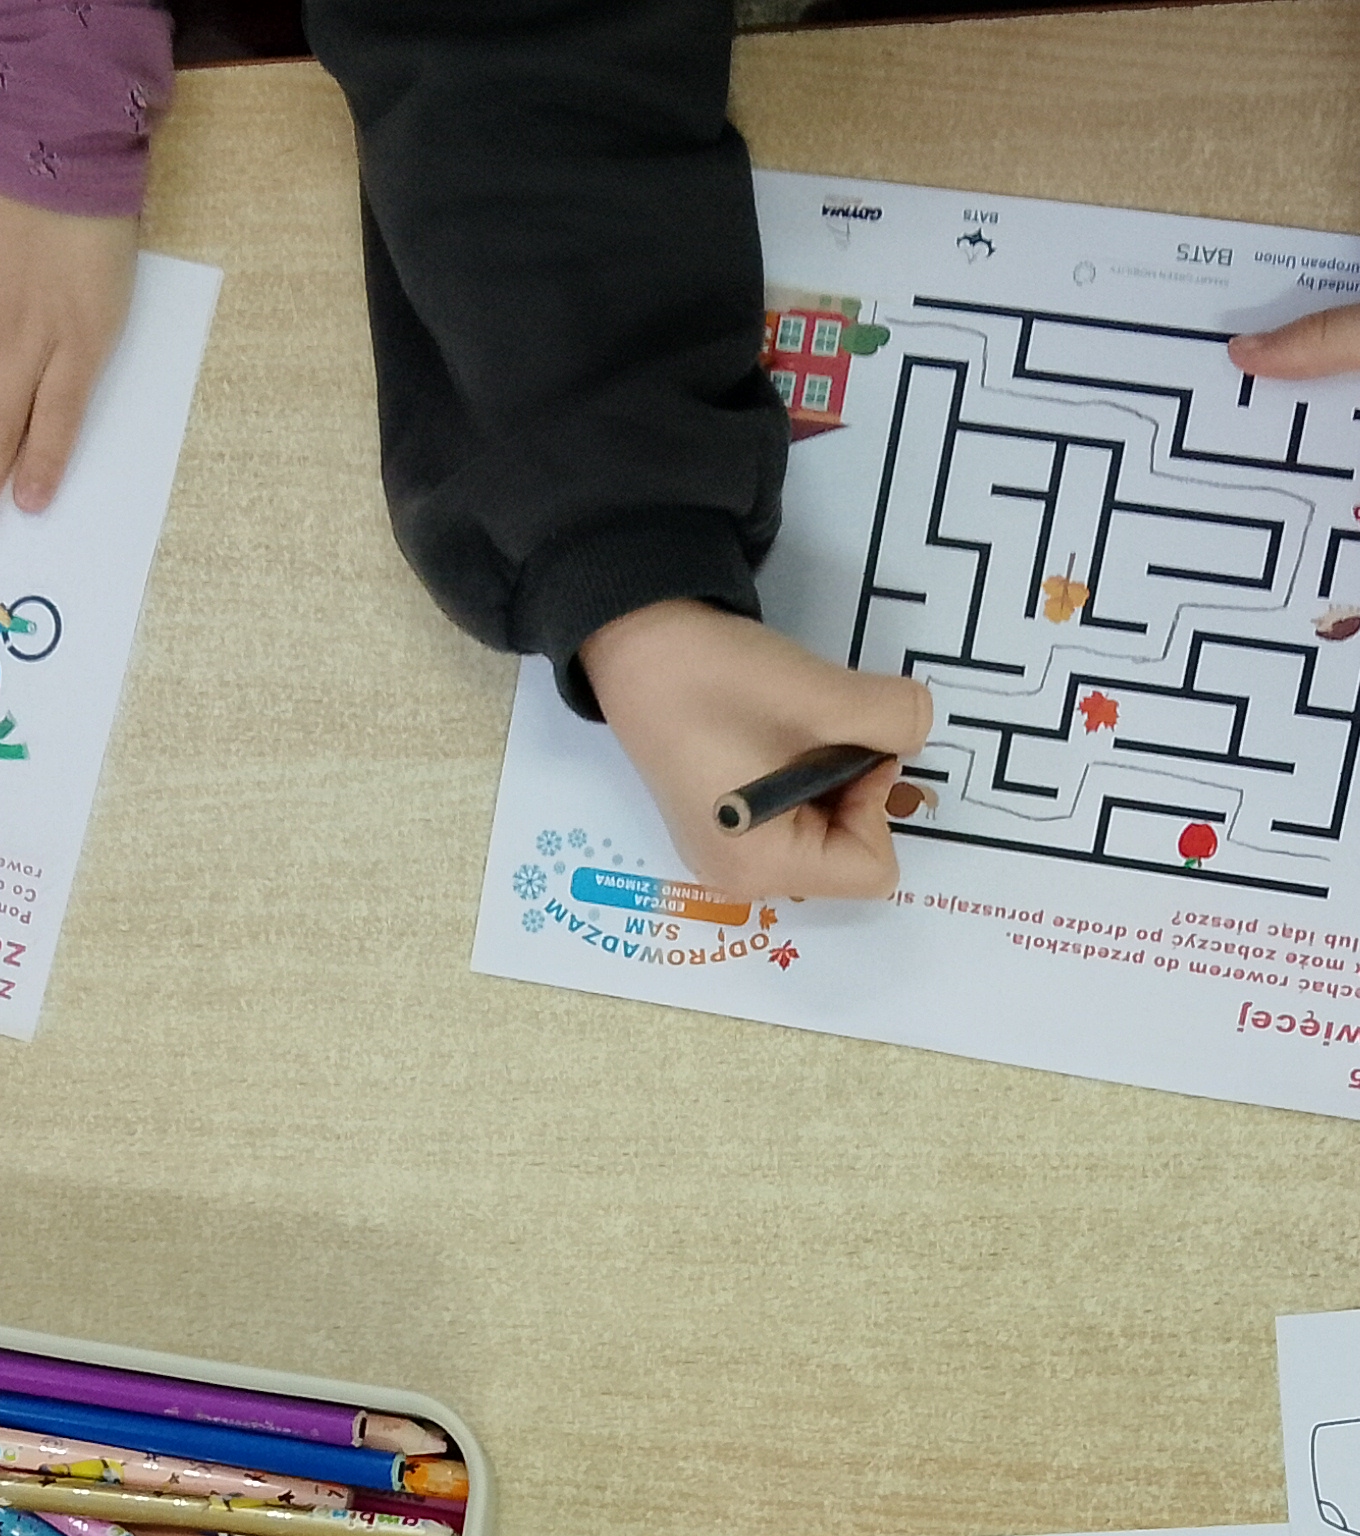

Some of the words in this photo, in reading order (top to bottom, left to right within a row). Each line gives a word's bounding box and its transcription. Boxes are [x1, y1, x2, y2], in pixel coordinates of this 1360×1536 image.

[962, 208, 1000, 226] BATS
[1176, 243, 1234, 268] BATS
[1253, 250, 1297, 271] Union
[1295, 271, 1316, 292] by
[923, 892, 1045, 926] poruszając
[543, 897, 769, 964] ODPROWADZAM
[624, 916, 680, 942] SAM
[1051, 915, 1128, 942] drodze
[1135, 927, 1164, 944] po
[1170, 909, 1260, 937] pieszo?
[1266, 922, 1316, 947] idąc
[1170, 932, 1278, 962] zobaczyć
[1323, 932, 1360, 954] lub
[1152, 955, 1181, 974] do
[1188, 960, 1290, 988] rowerem
[1284, 951, 1346, 972] może
